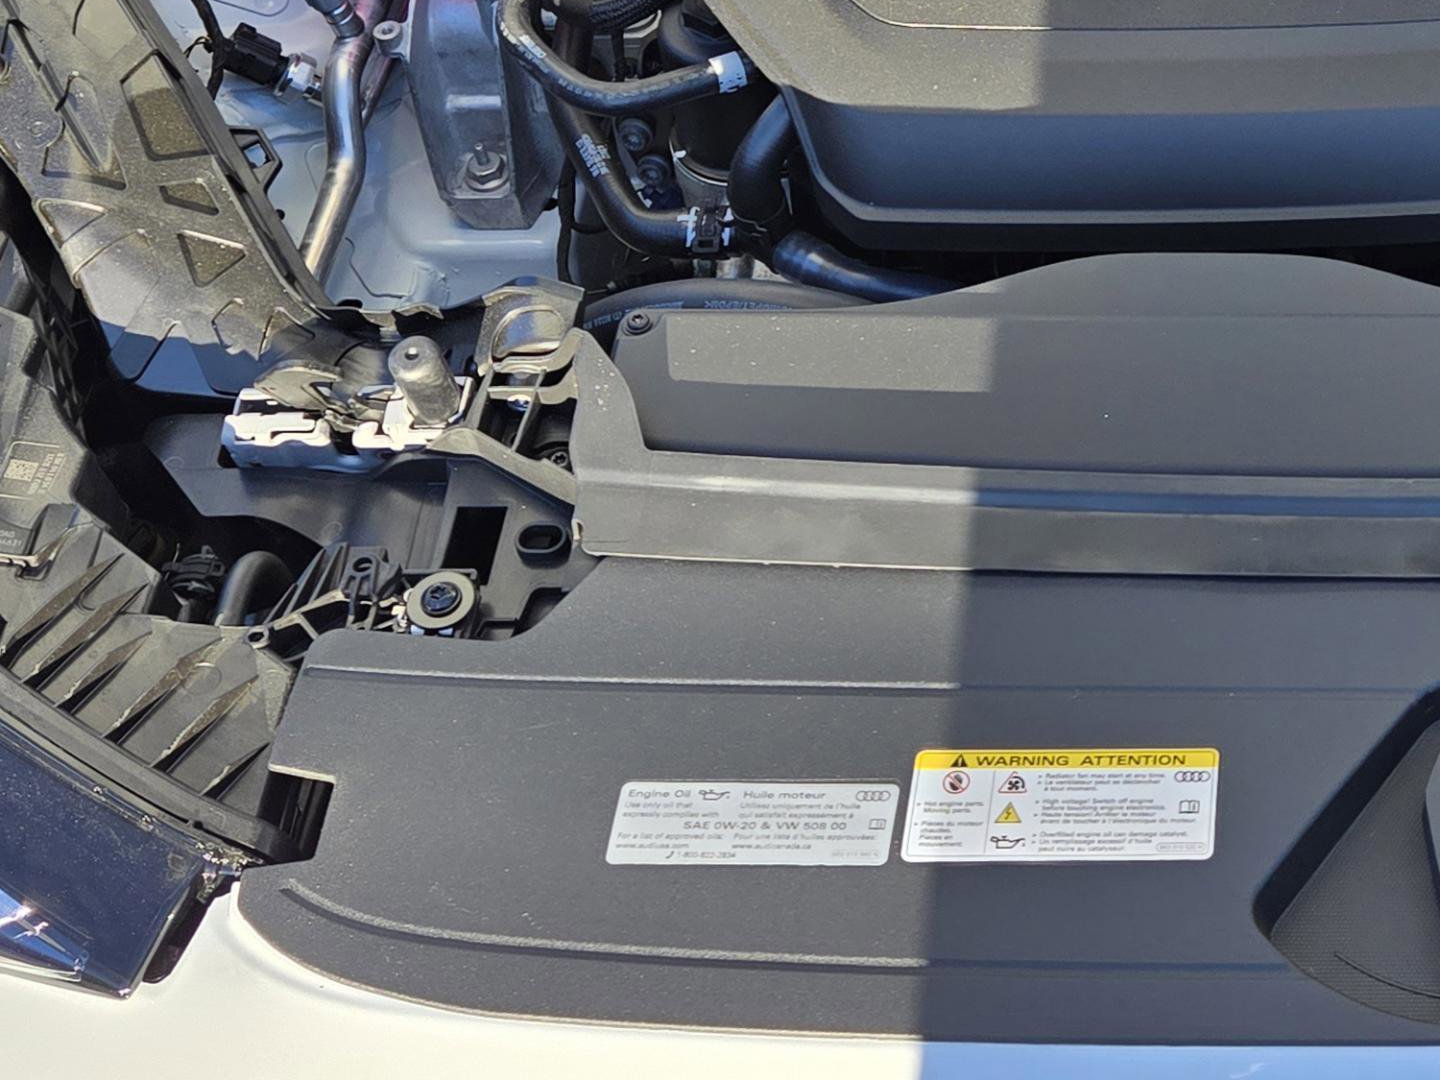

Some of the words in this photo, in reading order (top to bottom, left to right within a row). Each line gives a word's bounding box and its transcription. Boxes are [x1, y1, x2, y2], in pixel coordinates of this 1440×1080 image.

[976, 755, 1070, 767] WARNING
[1080, 755, 1187, 766] ATTENTION
[628, 789, 670, 800] Engine
[674, 788, 692, 799] Oil
[743, 791, 775, 800] Huile
[778, 791, 826, 800] moteur
[683, 821, 711, 830] SAE
[714, 821, 758, 830] 0W-20
[760, 822, 771, 830] &
[776, 822, 800, 830] VW
[803, 822, 827, 831] 508
[830, 822, 848, 831] 00
